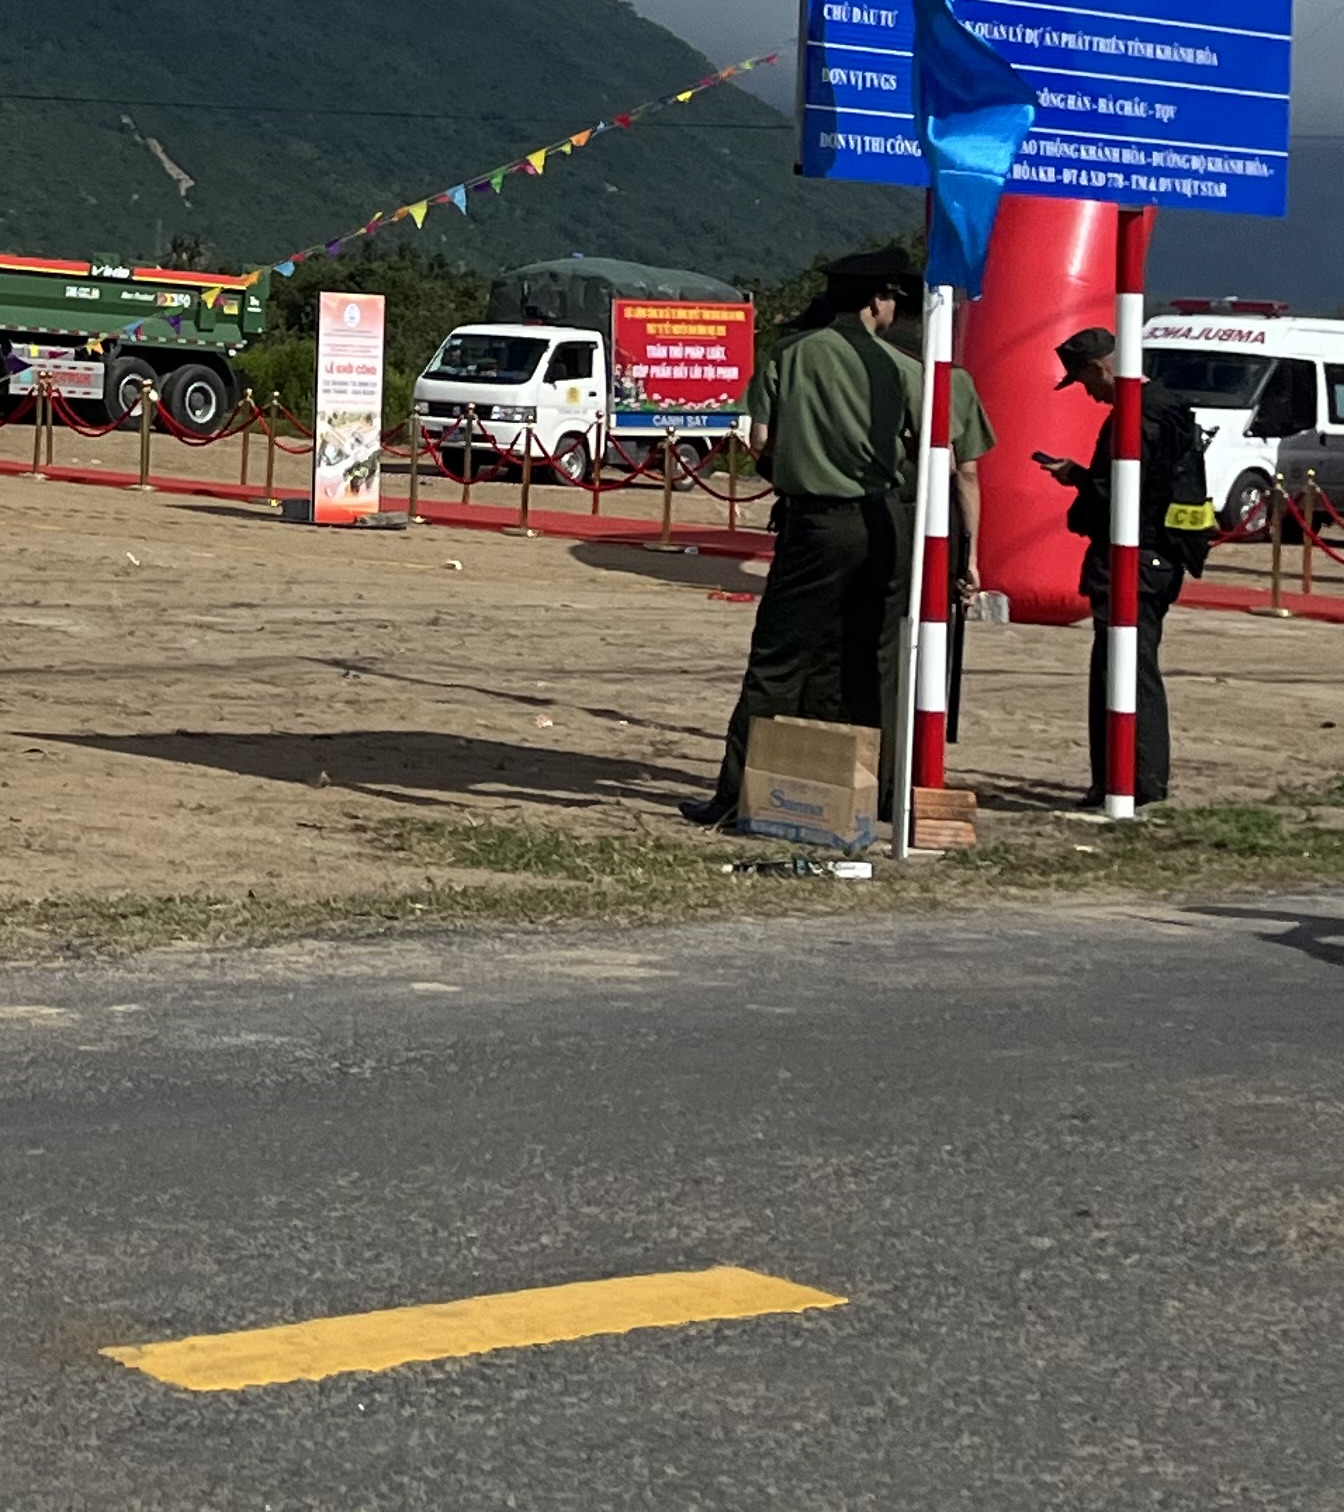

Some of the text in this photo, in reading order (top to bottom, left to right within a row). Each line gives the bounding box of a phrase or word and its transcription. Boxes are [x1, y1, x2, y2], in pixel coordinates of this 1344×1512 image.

[823, 1, 851, 23] CHỦ
[864, 136, 885, 154] THI
[887, 135, 922, 157] CÔNG
